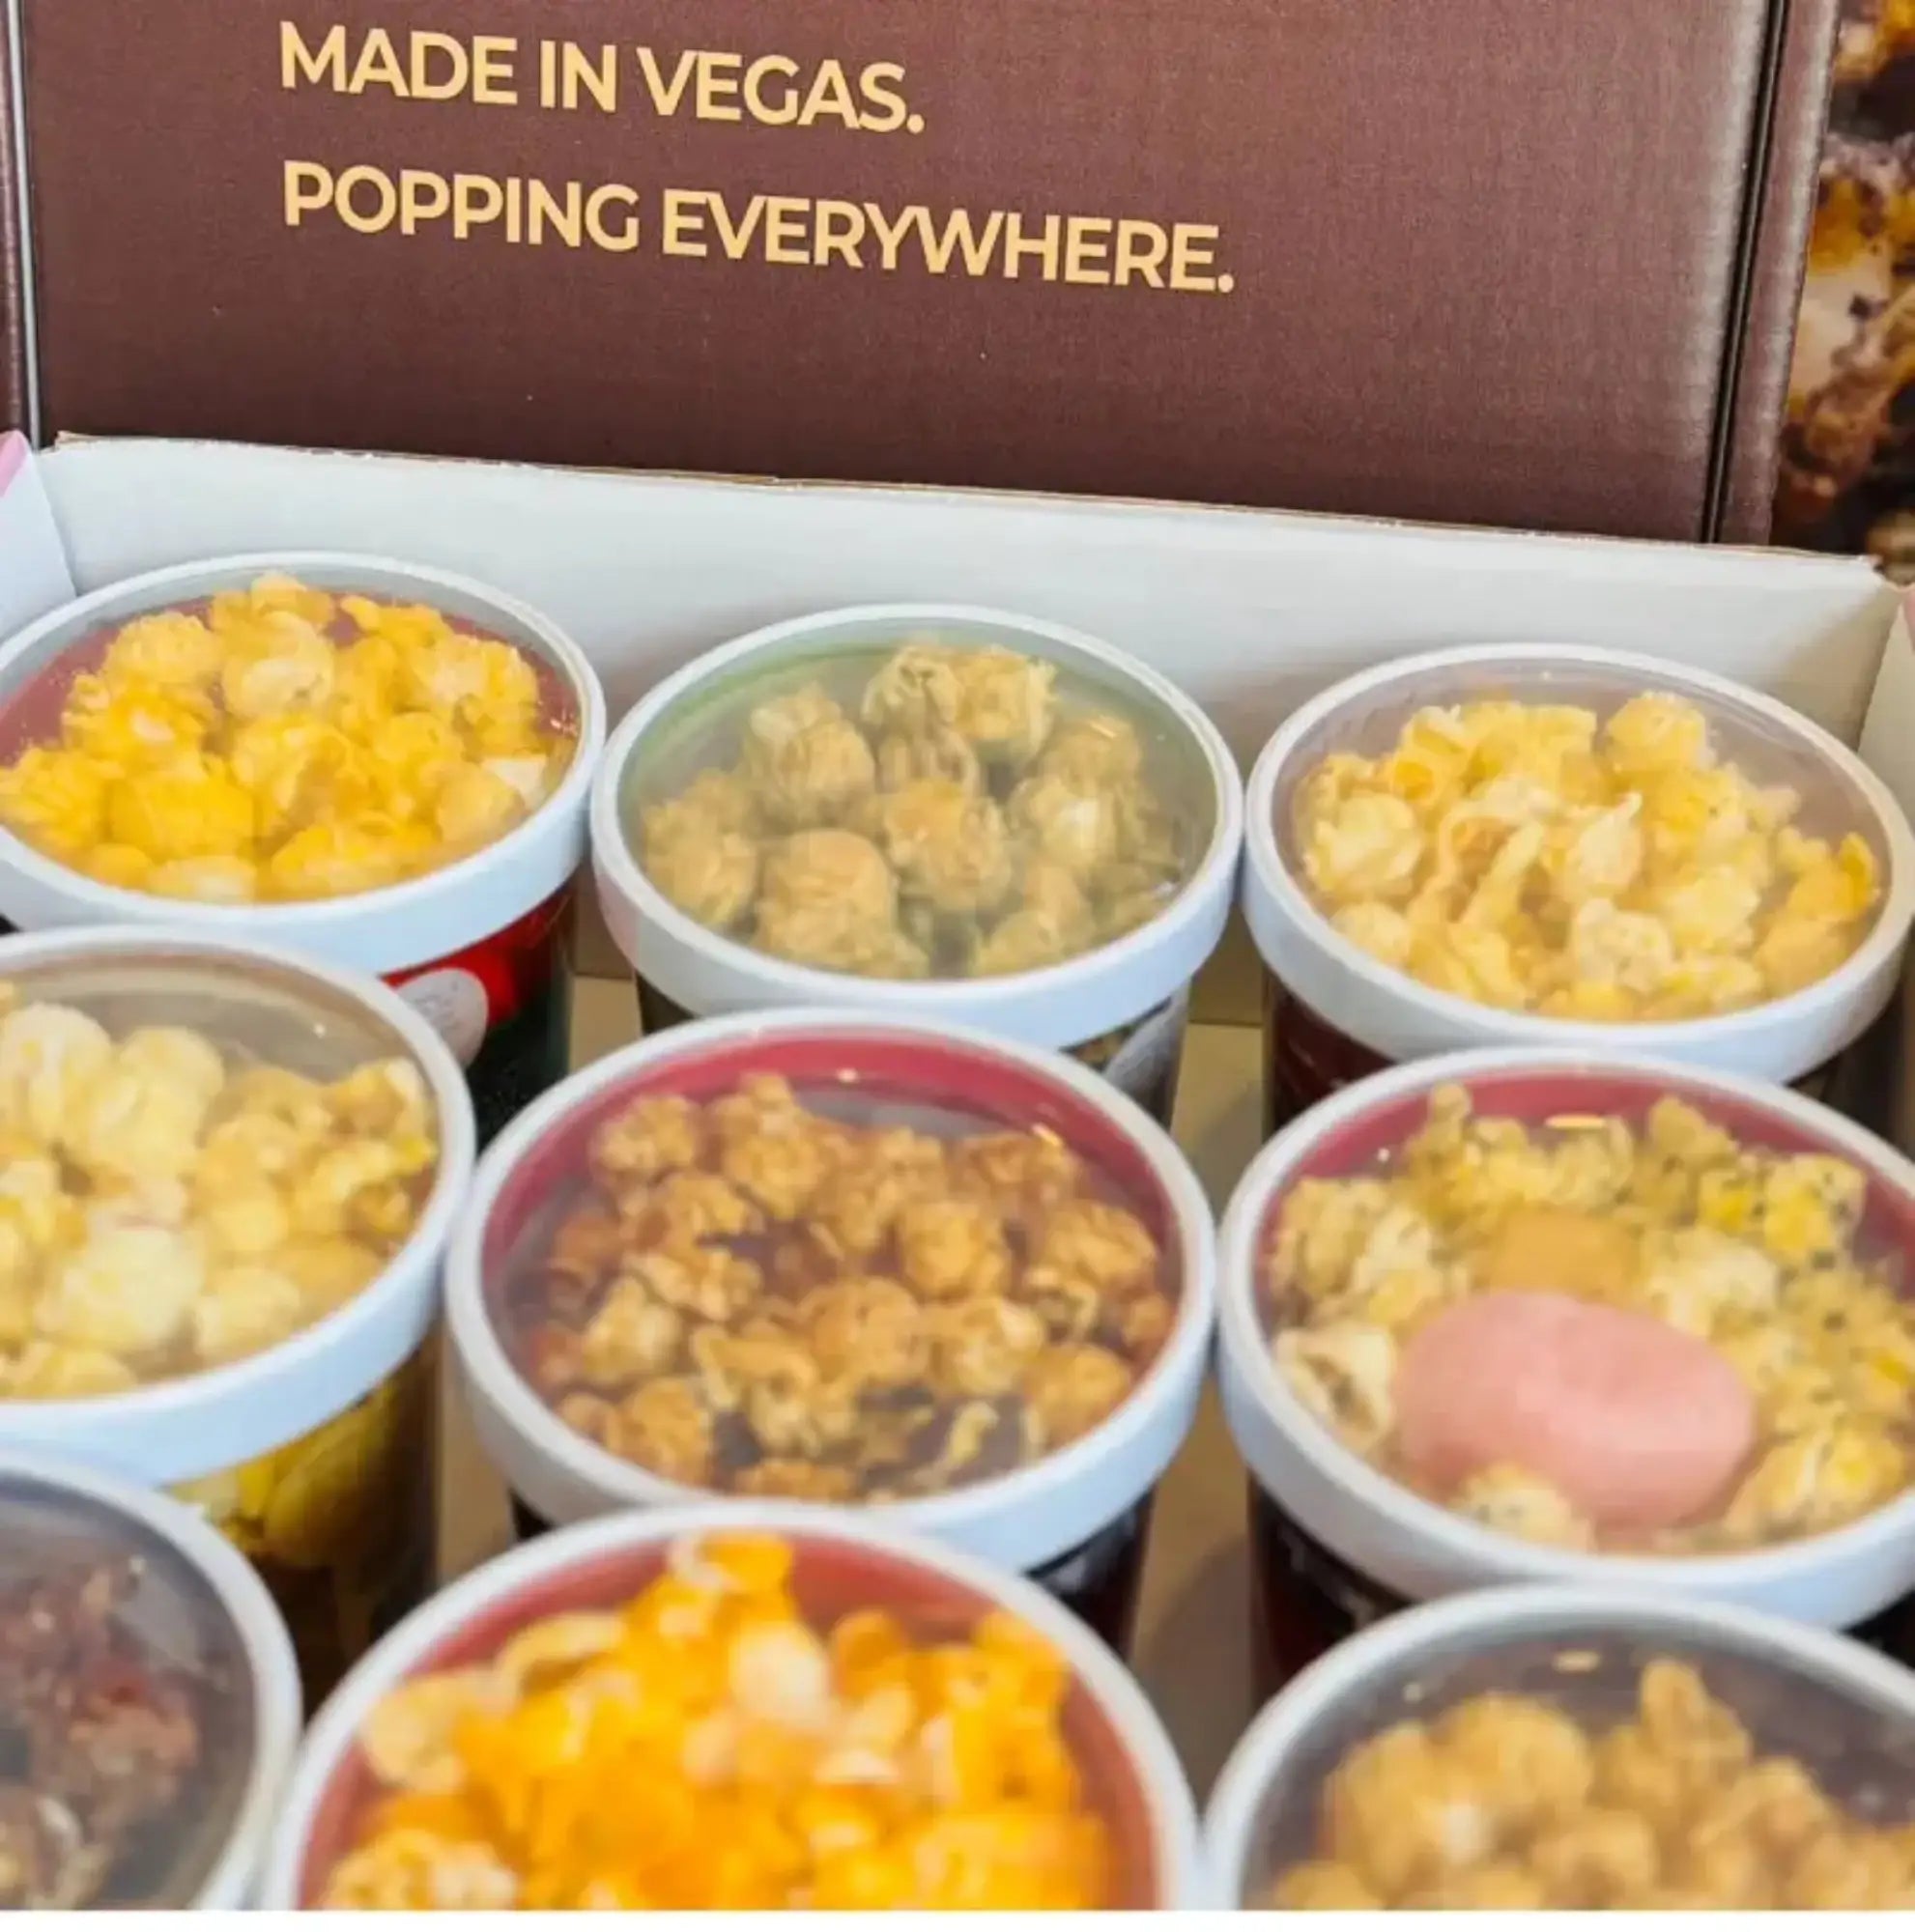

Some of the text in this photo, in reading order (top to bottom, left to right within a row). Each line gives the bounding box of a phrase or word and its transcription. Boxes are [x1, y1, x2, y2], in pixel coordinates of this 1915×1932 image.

[280, 21, 925, 134] MADE IN VEGAS.
[284, 160, 1235, 294] POPPING EVERYWHERE.
